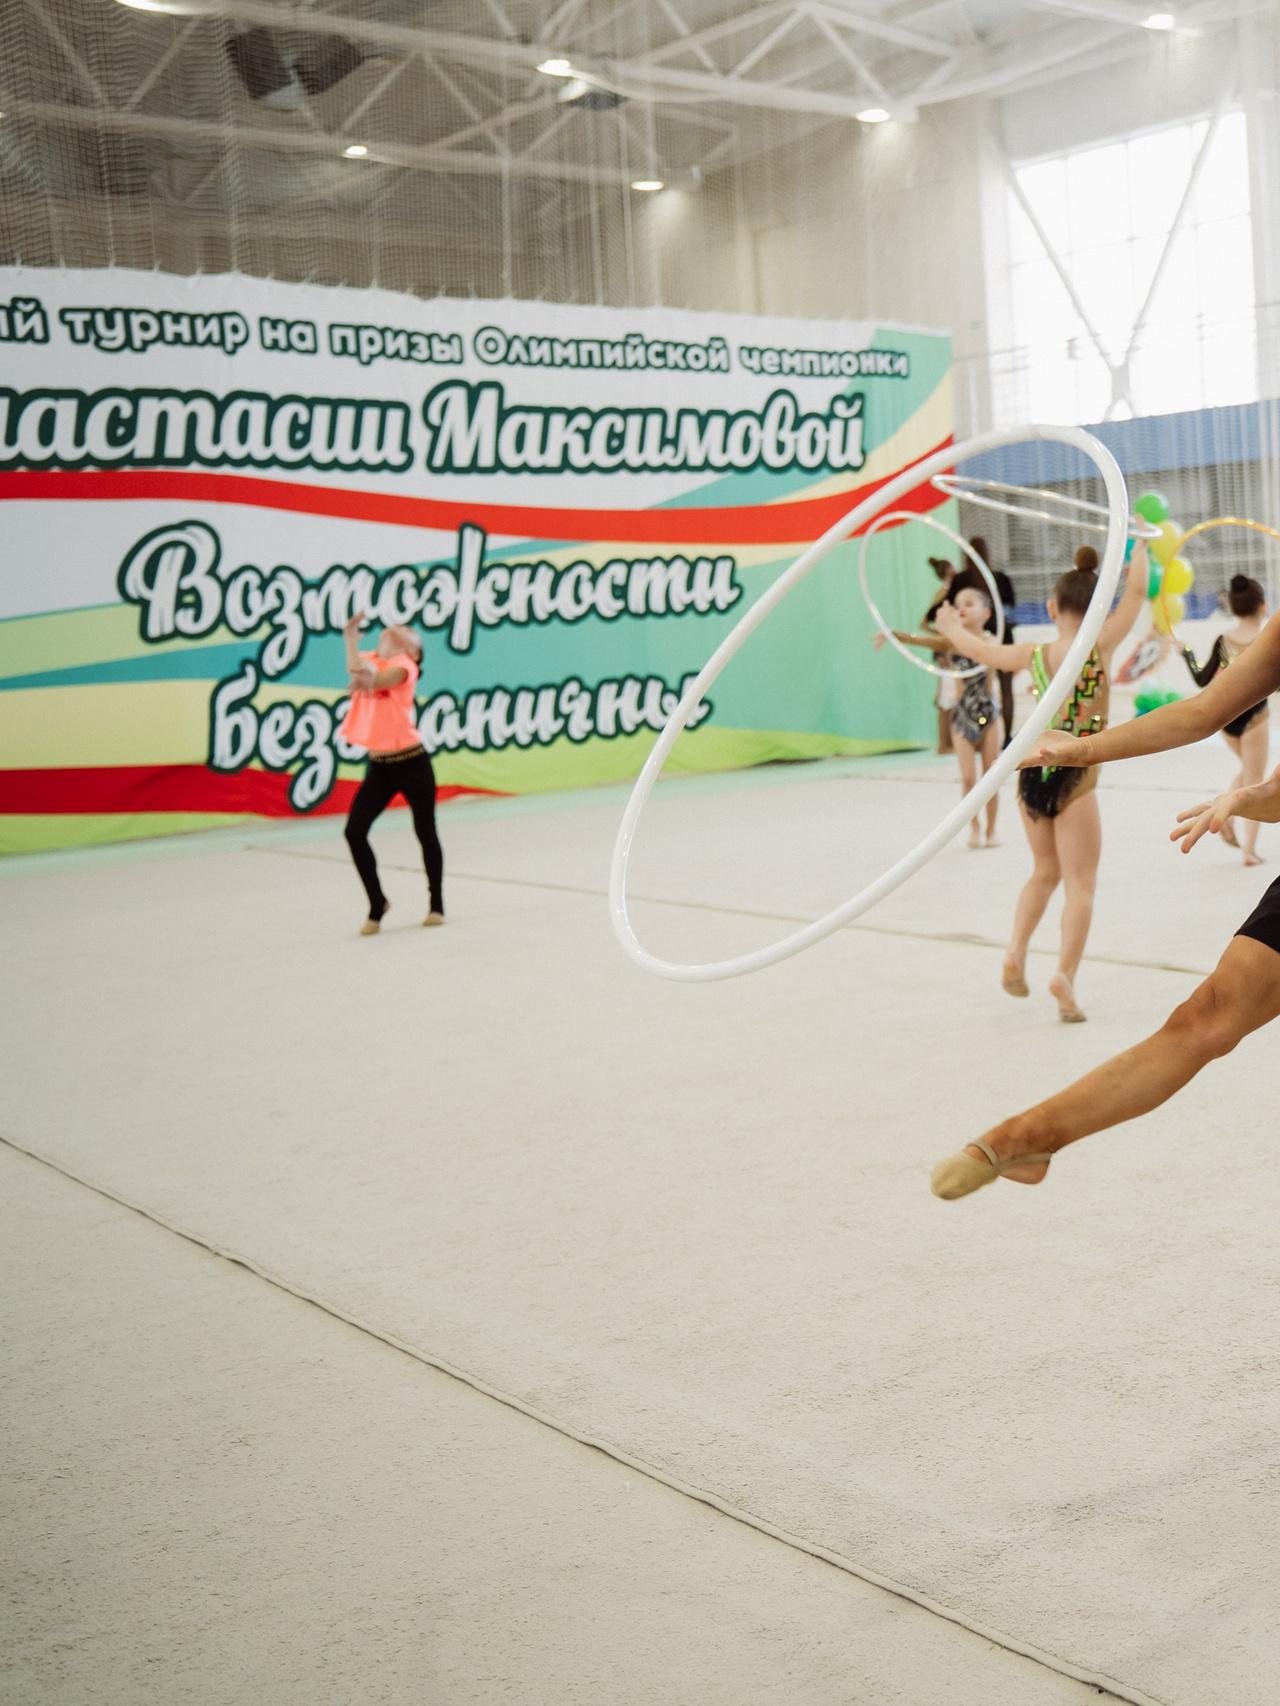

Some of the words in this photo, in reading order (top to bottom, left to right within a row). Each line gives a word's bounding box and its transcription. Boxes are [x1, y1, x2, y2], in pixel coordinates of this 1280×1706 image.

[59, 308, 248, 354] турнир
[260, 317, 317, 354] на
[329, 324, 463, 366] призы
[474, 326, 730, 373] Олимпийской
[739, 347, 909, 378] чемпионки
[421, 379, 866, 475] Максимовой
[118, 520, 741, 679] Возможности
